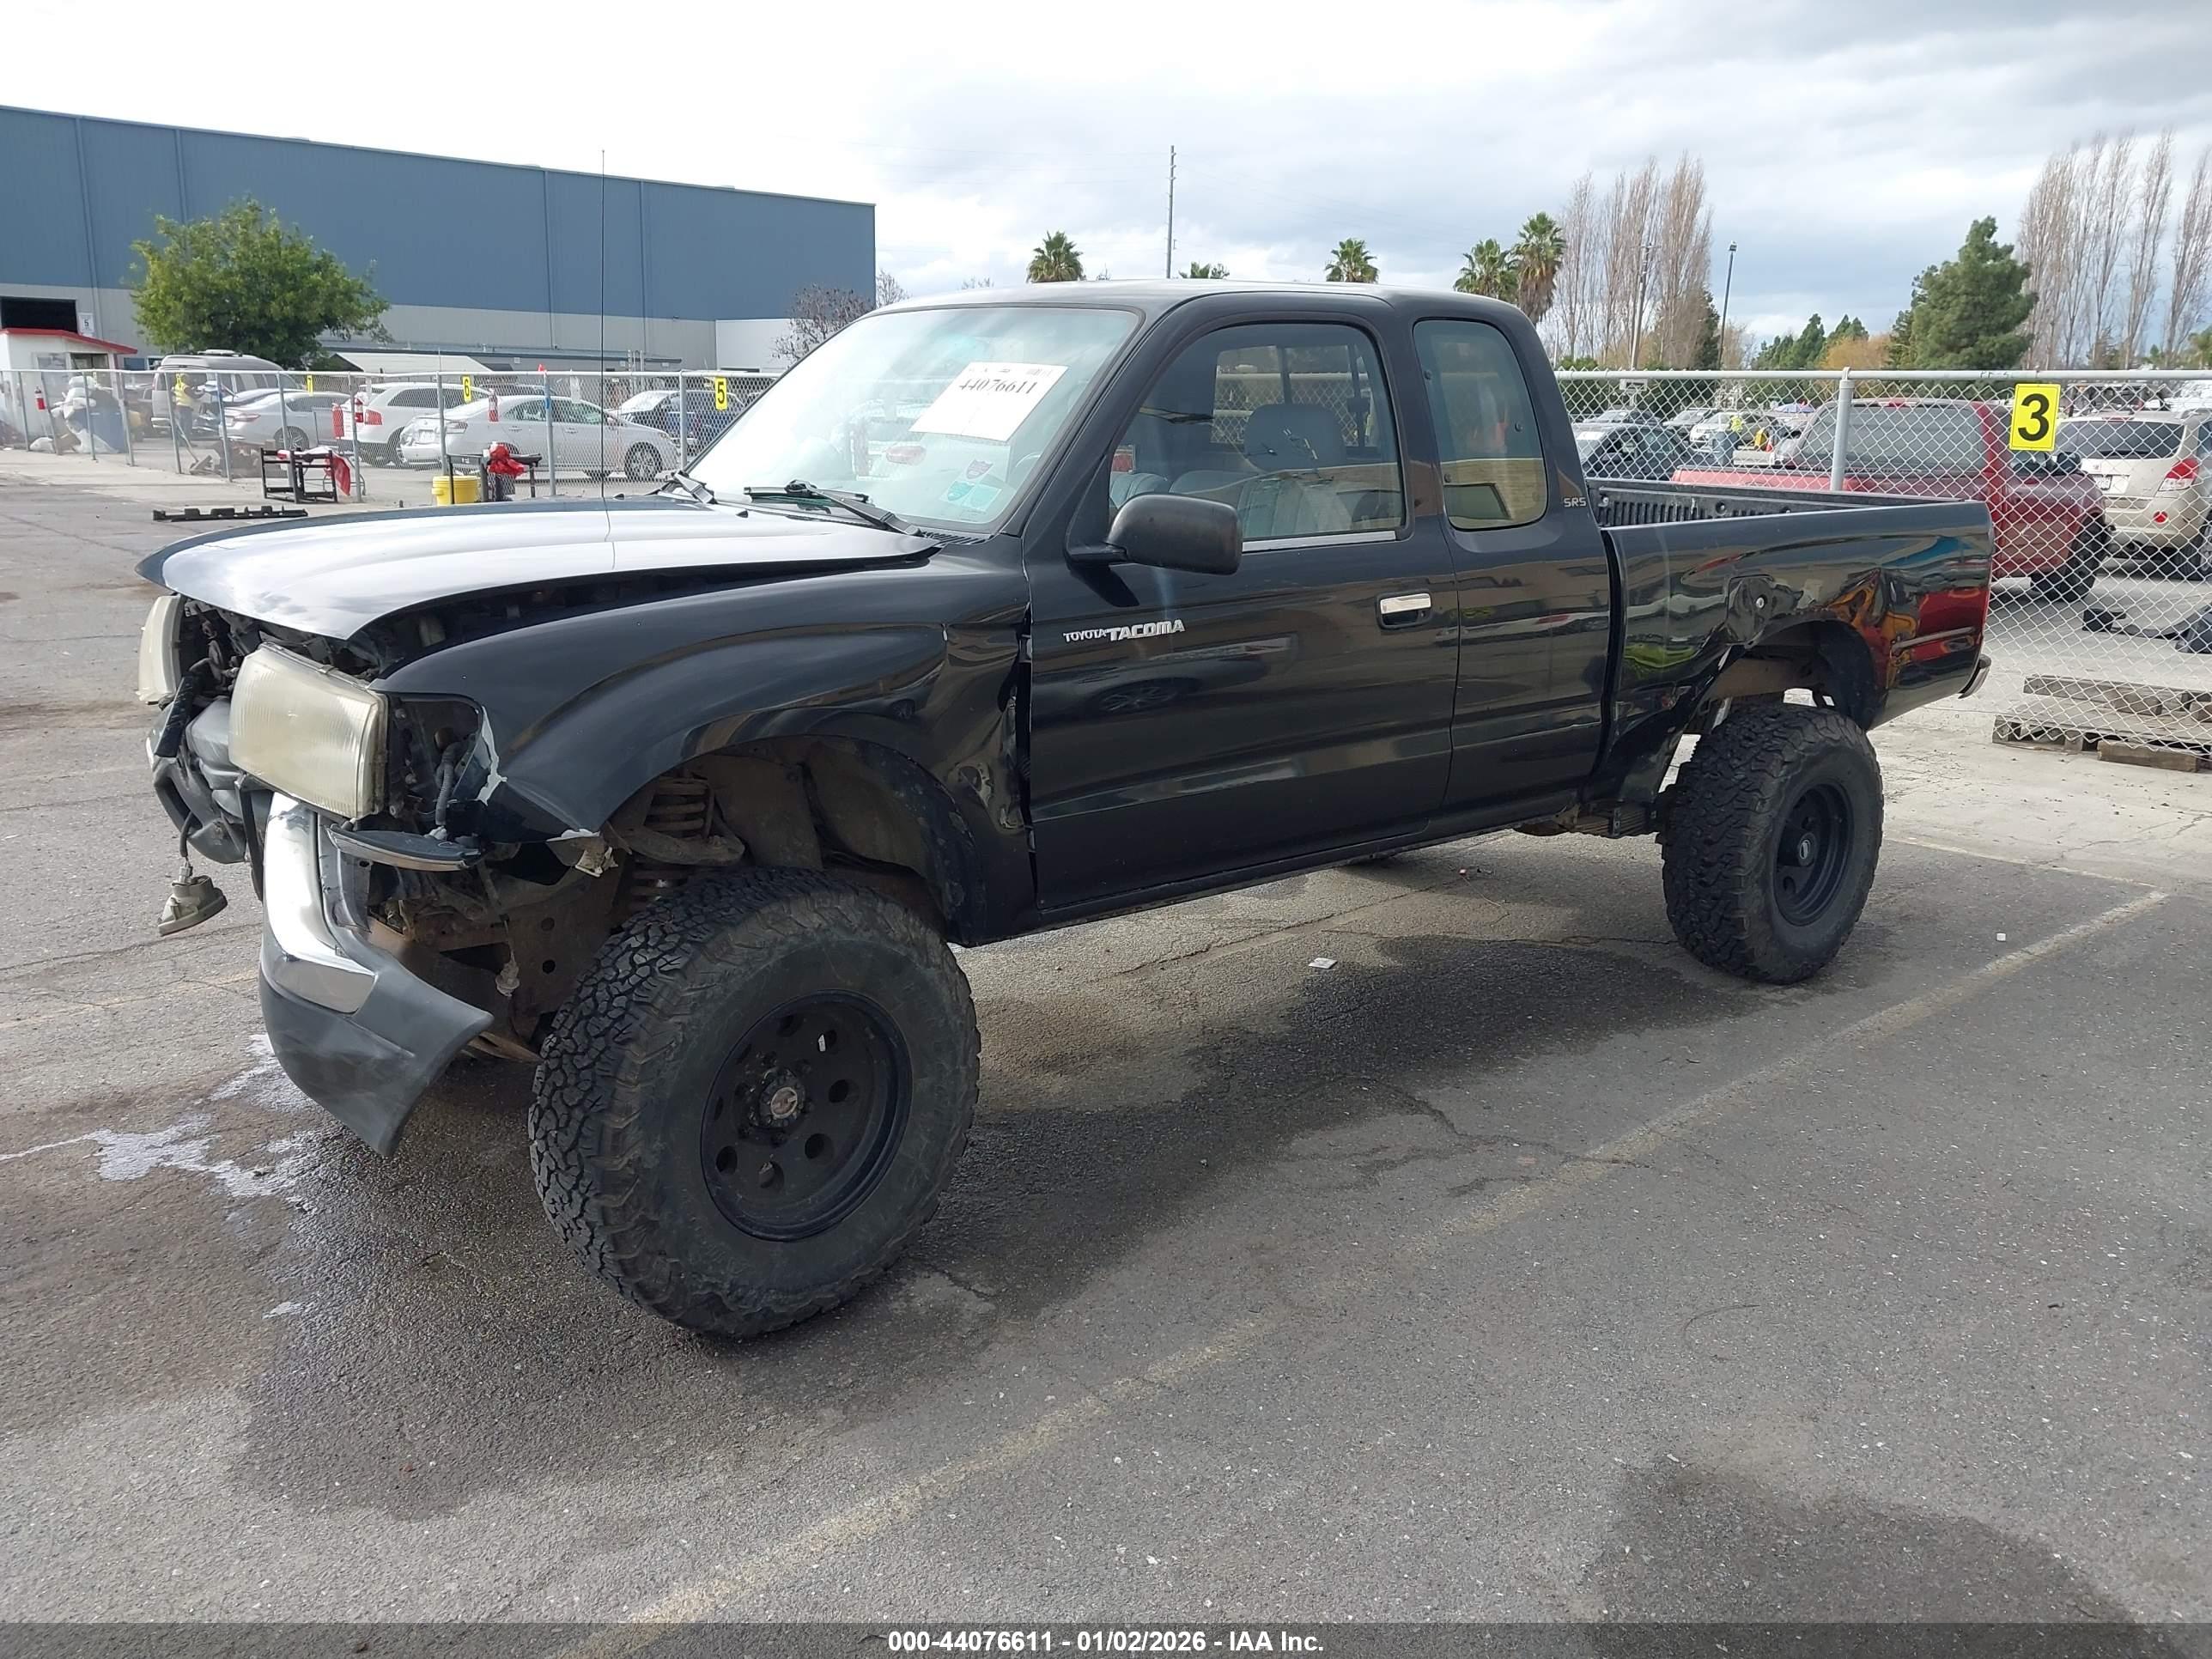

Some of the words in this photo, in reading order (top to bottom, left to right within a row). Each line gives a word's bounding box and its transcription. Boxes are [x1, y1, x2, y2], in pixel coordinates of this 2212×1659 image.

[464, 378, 470, 397] 6
[717, 381, 725, 404] 5
[959, 378, 1037, 394] 44076611
[2018, 393, 2050, 441] 3
[1063, 629, 1108, 642] TOYOTA
[1106, 619, 1185, 641] TACOMA
